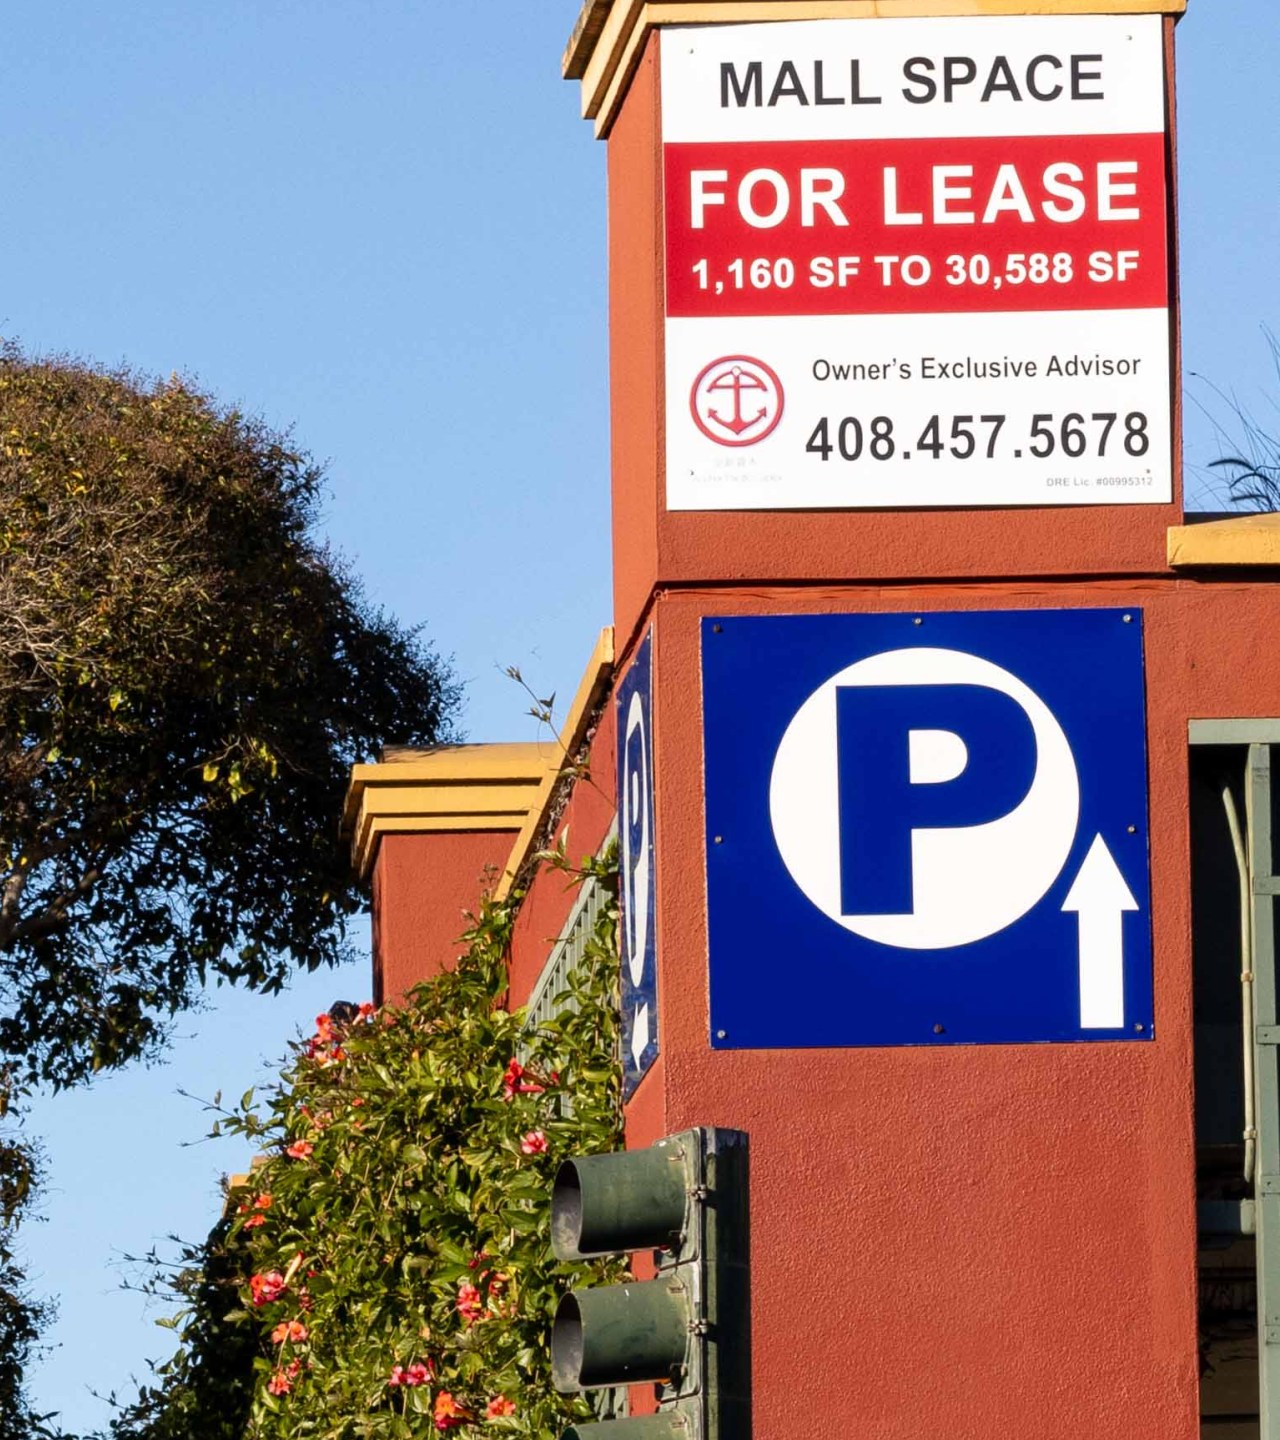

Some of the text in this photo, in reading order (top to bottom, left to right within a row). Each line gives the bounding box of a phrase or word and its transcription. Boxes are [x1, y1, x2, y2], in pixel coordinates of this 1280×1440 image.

[720, 54, 1105, 108] MALL SPACE
[690, 160, 1140, 229] FOR LEASE
[692, 250, 1140, 295] 1,160 SF TO 30,588 SF
[812, 354, 1142, 382] Owner's Exclusive Advisor
[805, 411, 1150, 462] 408.457.5678
[1046, 477, 1070, 487] DRE
[836, 683, 1038, 916] P
